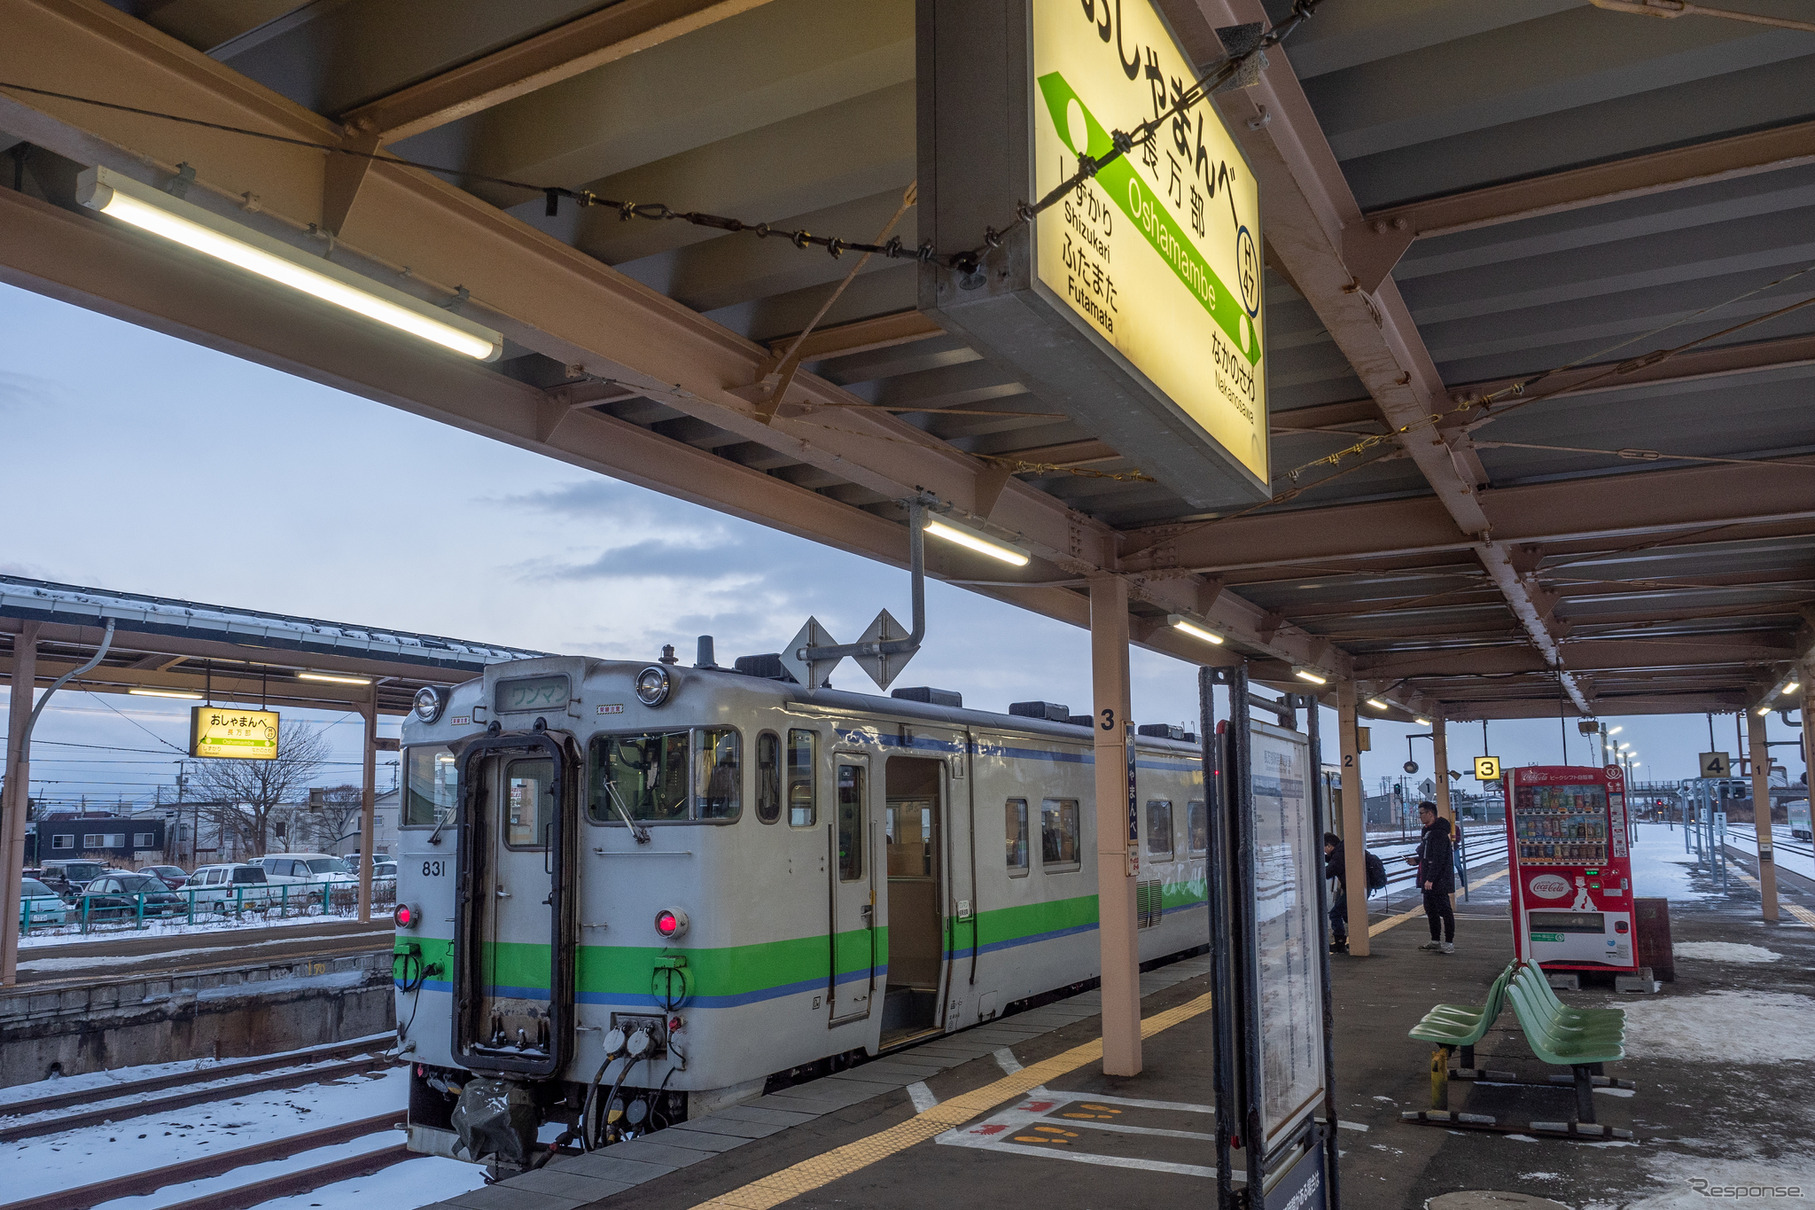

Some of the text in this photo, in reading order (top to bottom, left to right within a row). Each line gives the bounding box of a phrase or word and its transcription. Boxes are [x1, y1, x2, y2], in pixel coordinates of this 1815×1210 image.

[1142, 117, 1205, 239] 長万部
[1065, 200, 1111, 264] Shizukari
[1128, 177, 1216, 311] Oshamambe
[1244, 236, 1252, 271] H
[1062, 232, 1118, 313] ふたまた
[1243, 269, 1254, 303] 47
[1068, 275, 1114, 334] Futamata
[1211, 331, 1256, 404] なかのさわ
[1214, 369, 1255, 425] Nakanosawa
[512, 682, 569, 706] ワンマン
[211, 714, 267, 727] おしゃまんべ
[1101, 709, 1115, 730] 3
[1344, 754, 1353, 768] 2
[1480, 761, 1495, 776] 3
[1706, 757, 1725, 774] 4
[1756, 765, 1761, 776] 1
[1126, 734, 1137, 834] おしゃまんべ
[1425, 783, 1431, 793] 1
[422, 861, 446, 877] 831
[1532, 881, 1565, 892] Coca-Cola
